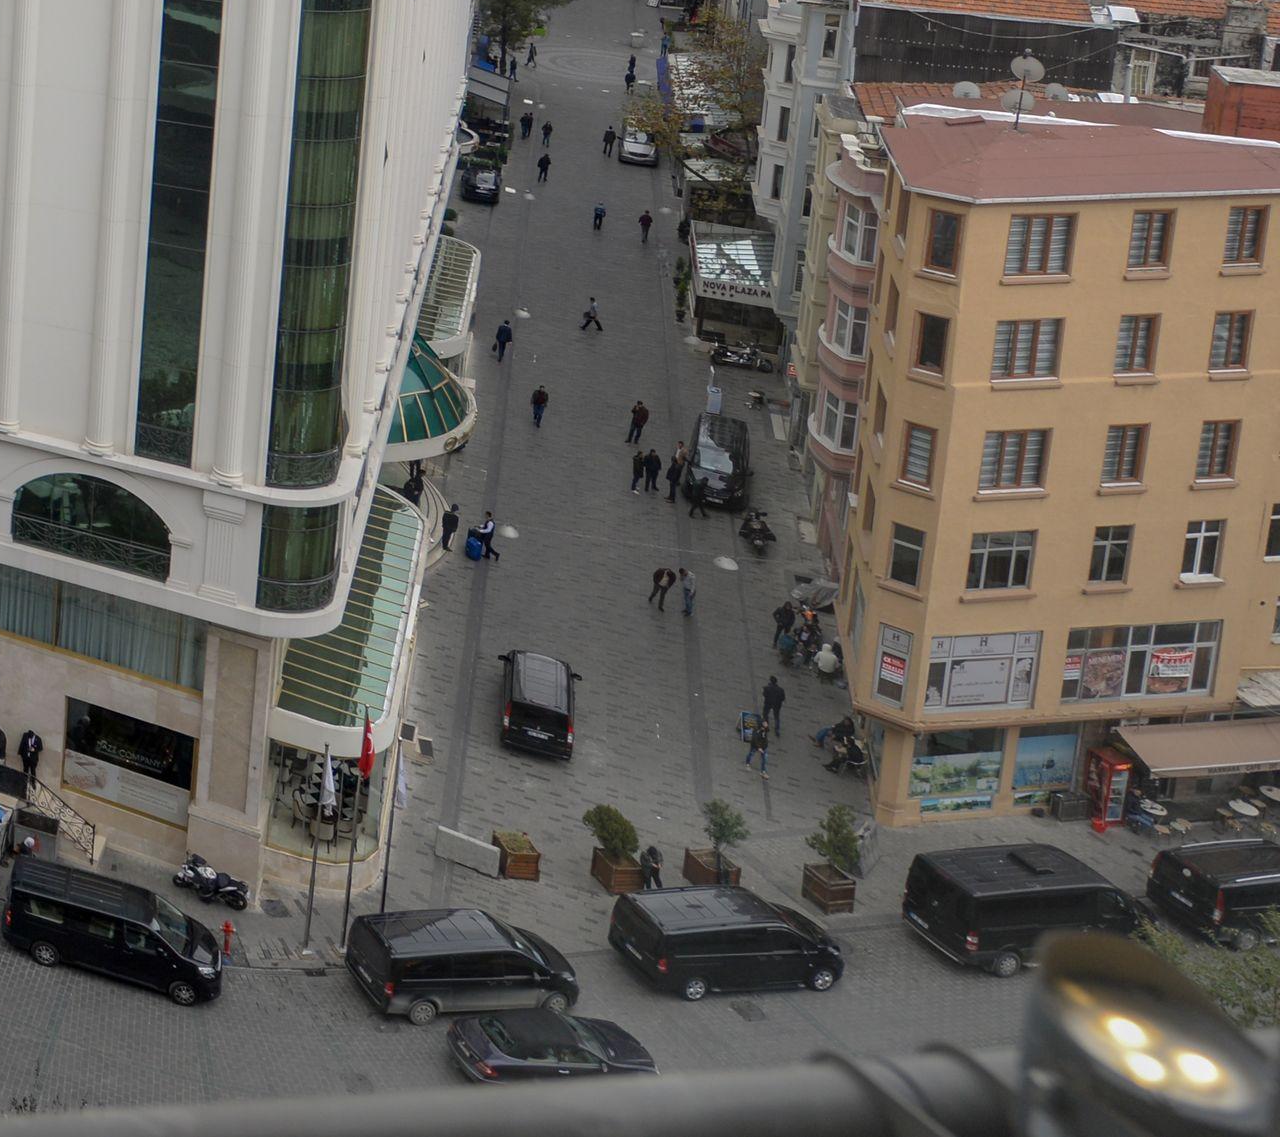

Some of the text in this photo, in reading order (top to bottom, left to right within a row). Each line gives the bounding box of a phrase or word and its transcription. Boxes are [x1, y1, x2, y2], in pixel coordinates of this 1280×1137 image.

[703, 281, 727, 292] NOVA
[729, 285, 758, 297] PLAZA
[120, 749, 162, 768] COMPANY
